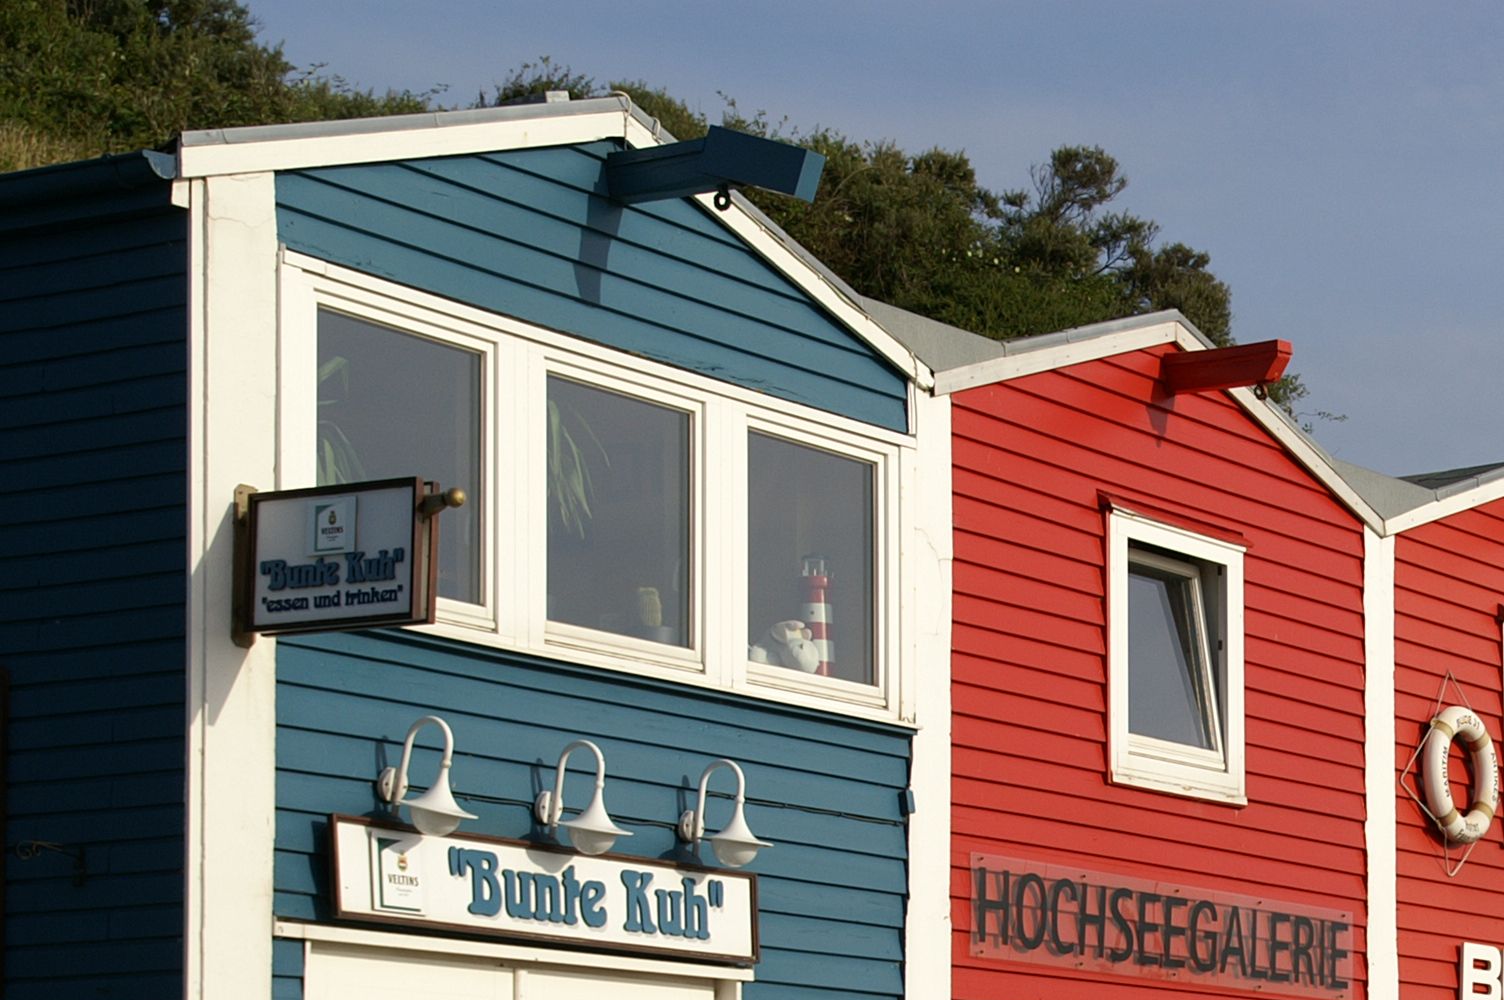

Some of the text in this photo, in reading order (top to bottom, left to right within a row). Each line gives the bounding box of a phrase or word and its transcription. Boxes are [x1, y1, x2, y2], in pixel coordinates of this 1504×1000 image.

[260, 547, 405, 591] "Bunte Kuh"
[262, 584, 403, 613] "essen und trinken"
[388, 873, 419, 887] VELTINS
[447, 845, 724, 941] "Bunte Kuh"
[976, 866, 1349, 990] HOCHSEEGALERIE
